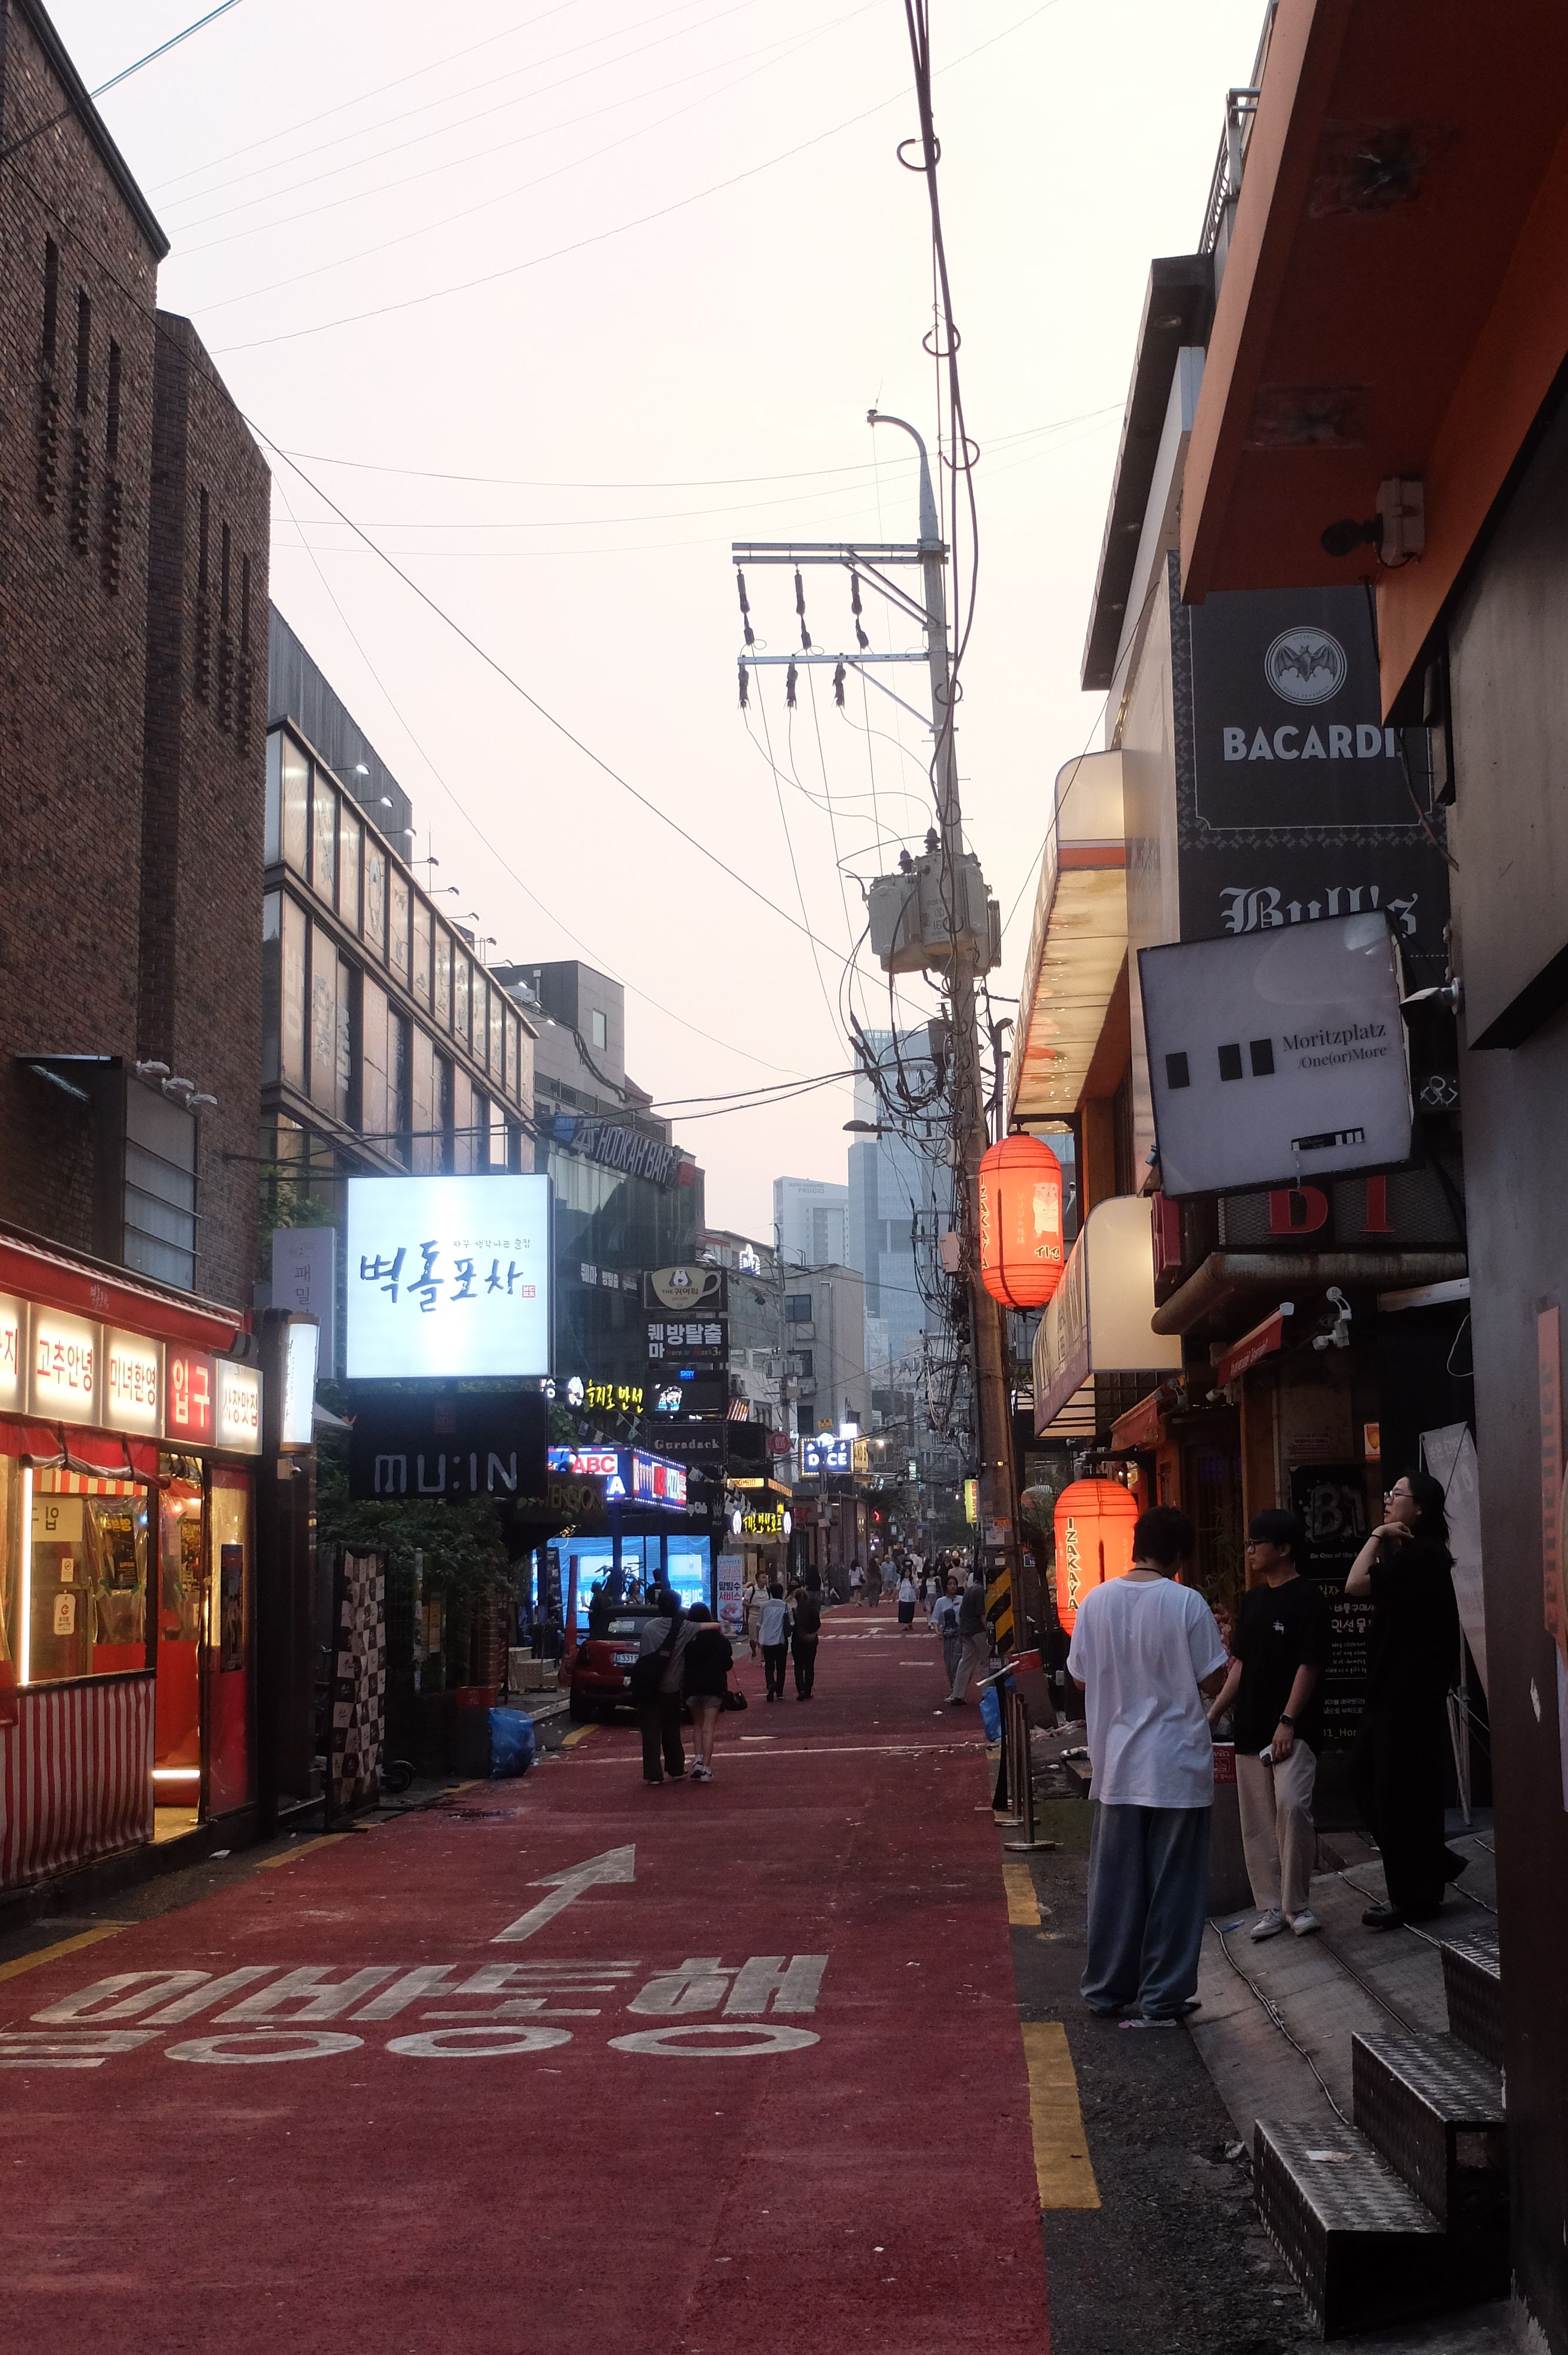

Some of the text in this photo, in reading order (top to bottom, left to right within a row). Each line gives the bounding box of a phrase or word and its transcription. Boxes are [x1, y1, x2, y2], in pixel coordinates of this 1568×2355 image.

[1224, 724, 1396, 761] BACARDI
[1283, 1022, 1387, 1052] Moritzplatz
[596, 1127, 673, 1184] HOOKAH BAR
[453, 1238, 531, 1250] 자꾸 생각나는 술집
[294, 1264, 311, 1314] 패밀
[360, 1240, 524, 1312] 벽돌포차
[0, 1328, 18, 1375] 지
[666, 1323, 722, 1345] 방탈출
[38, 1339, 92, 1392] 고추안녕
[110, 1356, 156, 1406] 미녀환영
[173, 1359, 211, 1428] 입구
[618, 1385, 644, 1414] 만선
[572, 1455, 615, 1474] ABC
[808, 1452, 847, 1466] DCE
[1065, 1517, 1081, 1611] IZAKAYA
[719, 1591, 741, 1601] 서비스
